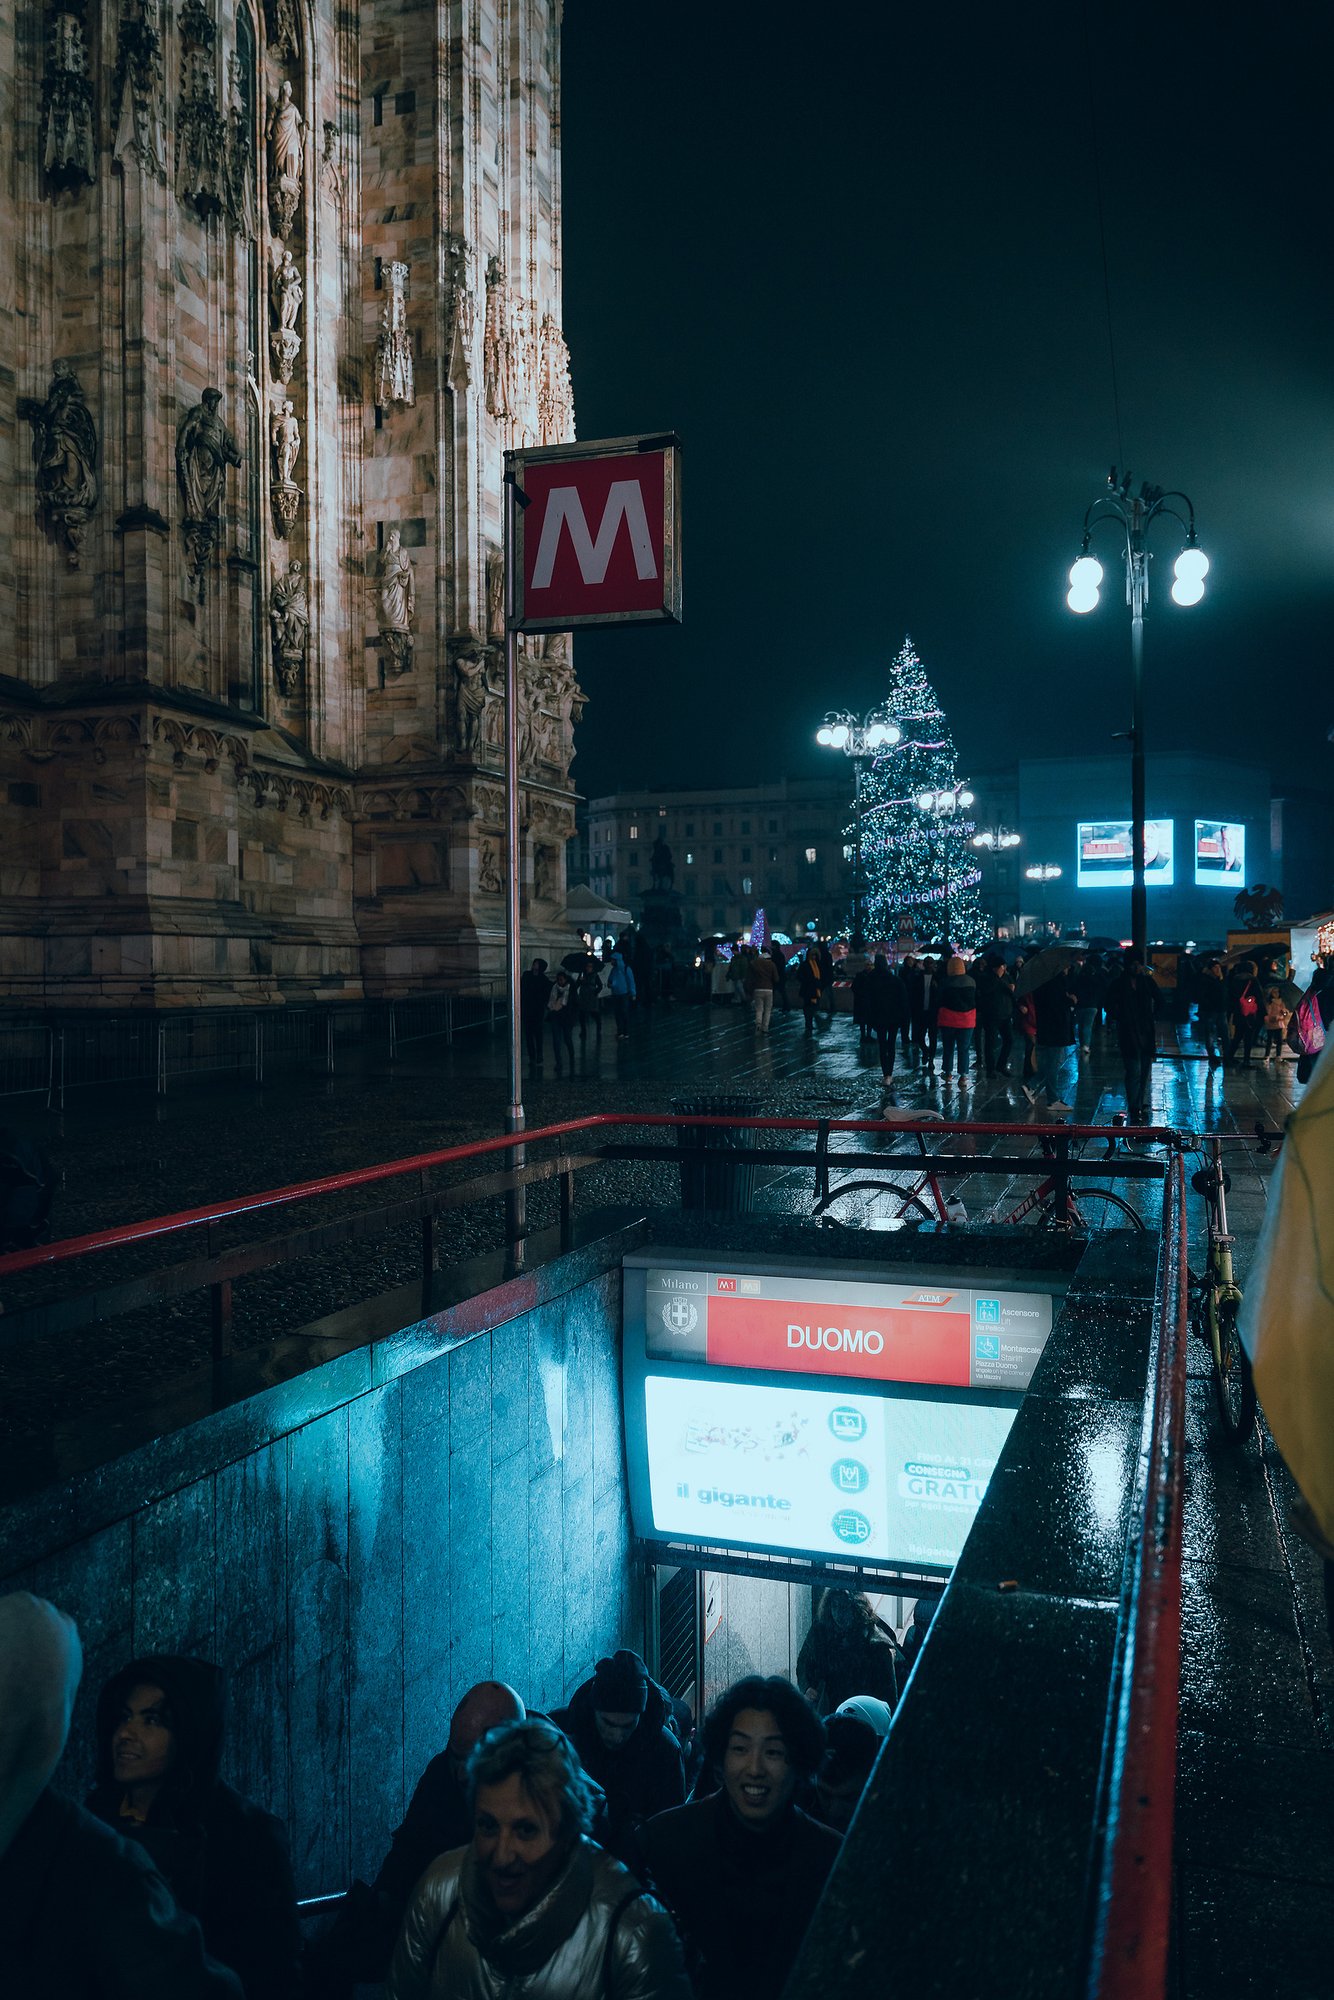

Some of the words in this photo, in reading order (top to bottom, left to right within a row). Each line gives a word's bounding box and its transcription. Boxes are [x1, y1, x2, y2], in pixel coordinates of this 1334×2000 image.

[531, 480, 658, 589] M
[900, 919, 913, 930] M
[661, 1278, 699, 1290] Milano
[719, 1280, 735, 1290] M1
[742, 1281, 758, 1291] M3
[917, 1294, 941, 1303] ATM
[1001, 1308, 1040, 1318] Ascensore
[1001, 1318, 1011, 1326] Lift
[787, 1324, 884, 1355] DUOMO
[1001, 1344, 1042, 1355] Montascale
[1001, 1353, 1023, 1363] Stairlift
[975, 1360, 995, 1368] Piazza
[995, 1361, 1018, 1370] Duomo
[908, 1465, 967, 1480] CONSEGNA
[676, 1482, 689, 1498] il
[697, 1486, 792, 1511] gigante
